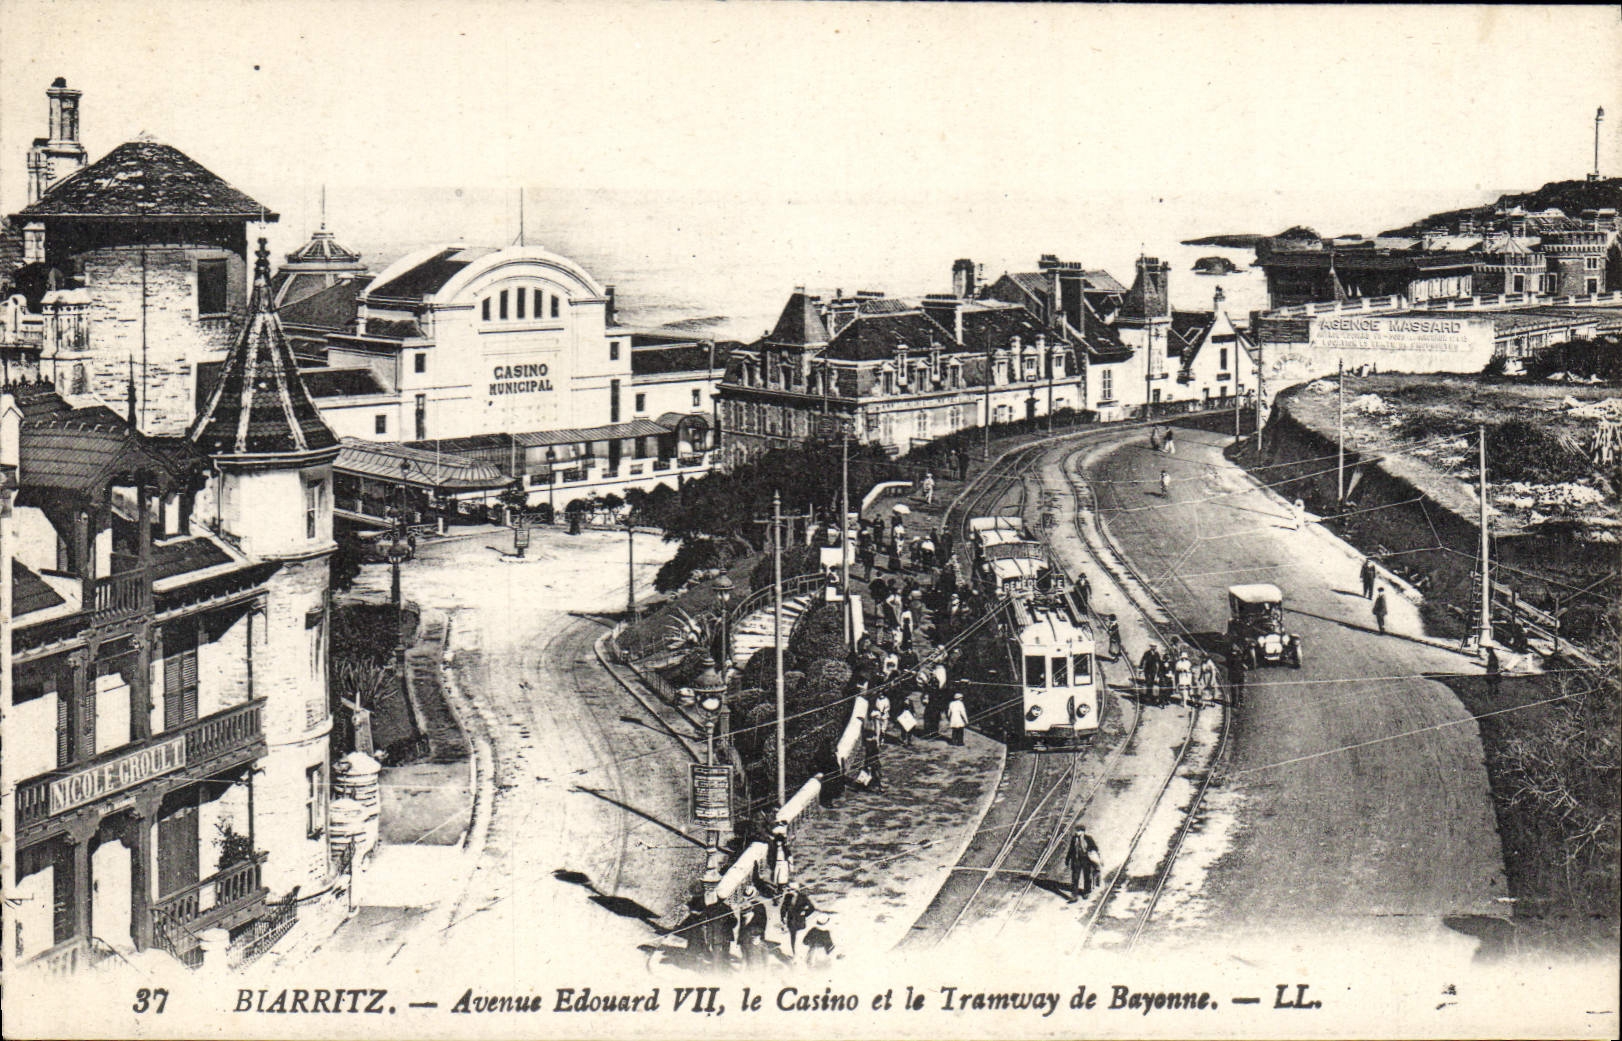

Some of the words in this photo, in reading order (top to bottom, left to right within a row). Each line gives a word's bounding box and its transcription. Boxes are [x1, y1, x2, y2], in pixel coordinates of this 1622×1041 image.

[1319, 319, 1380, 332] AGENCE
[1388, 320, 1461, 334] MASSARD
[493, 363, 548, 380] CASINO
[489, 379, 553, 396] MUNICIPAL
[53, 764, 115, 811] NICOLE
[119, 740, 182, 785] GROULT
